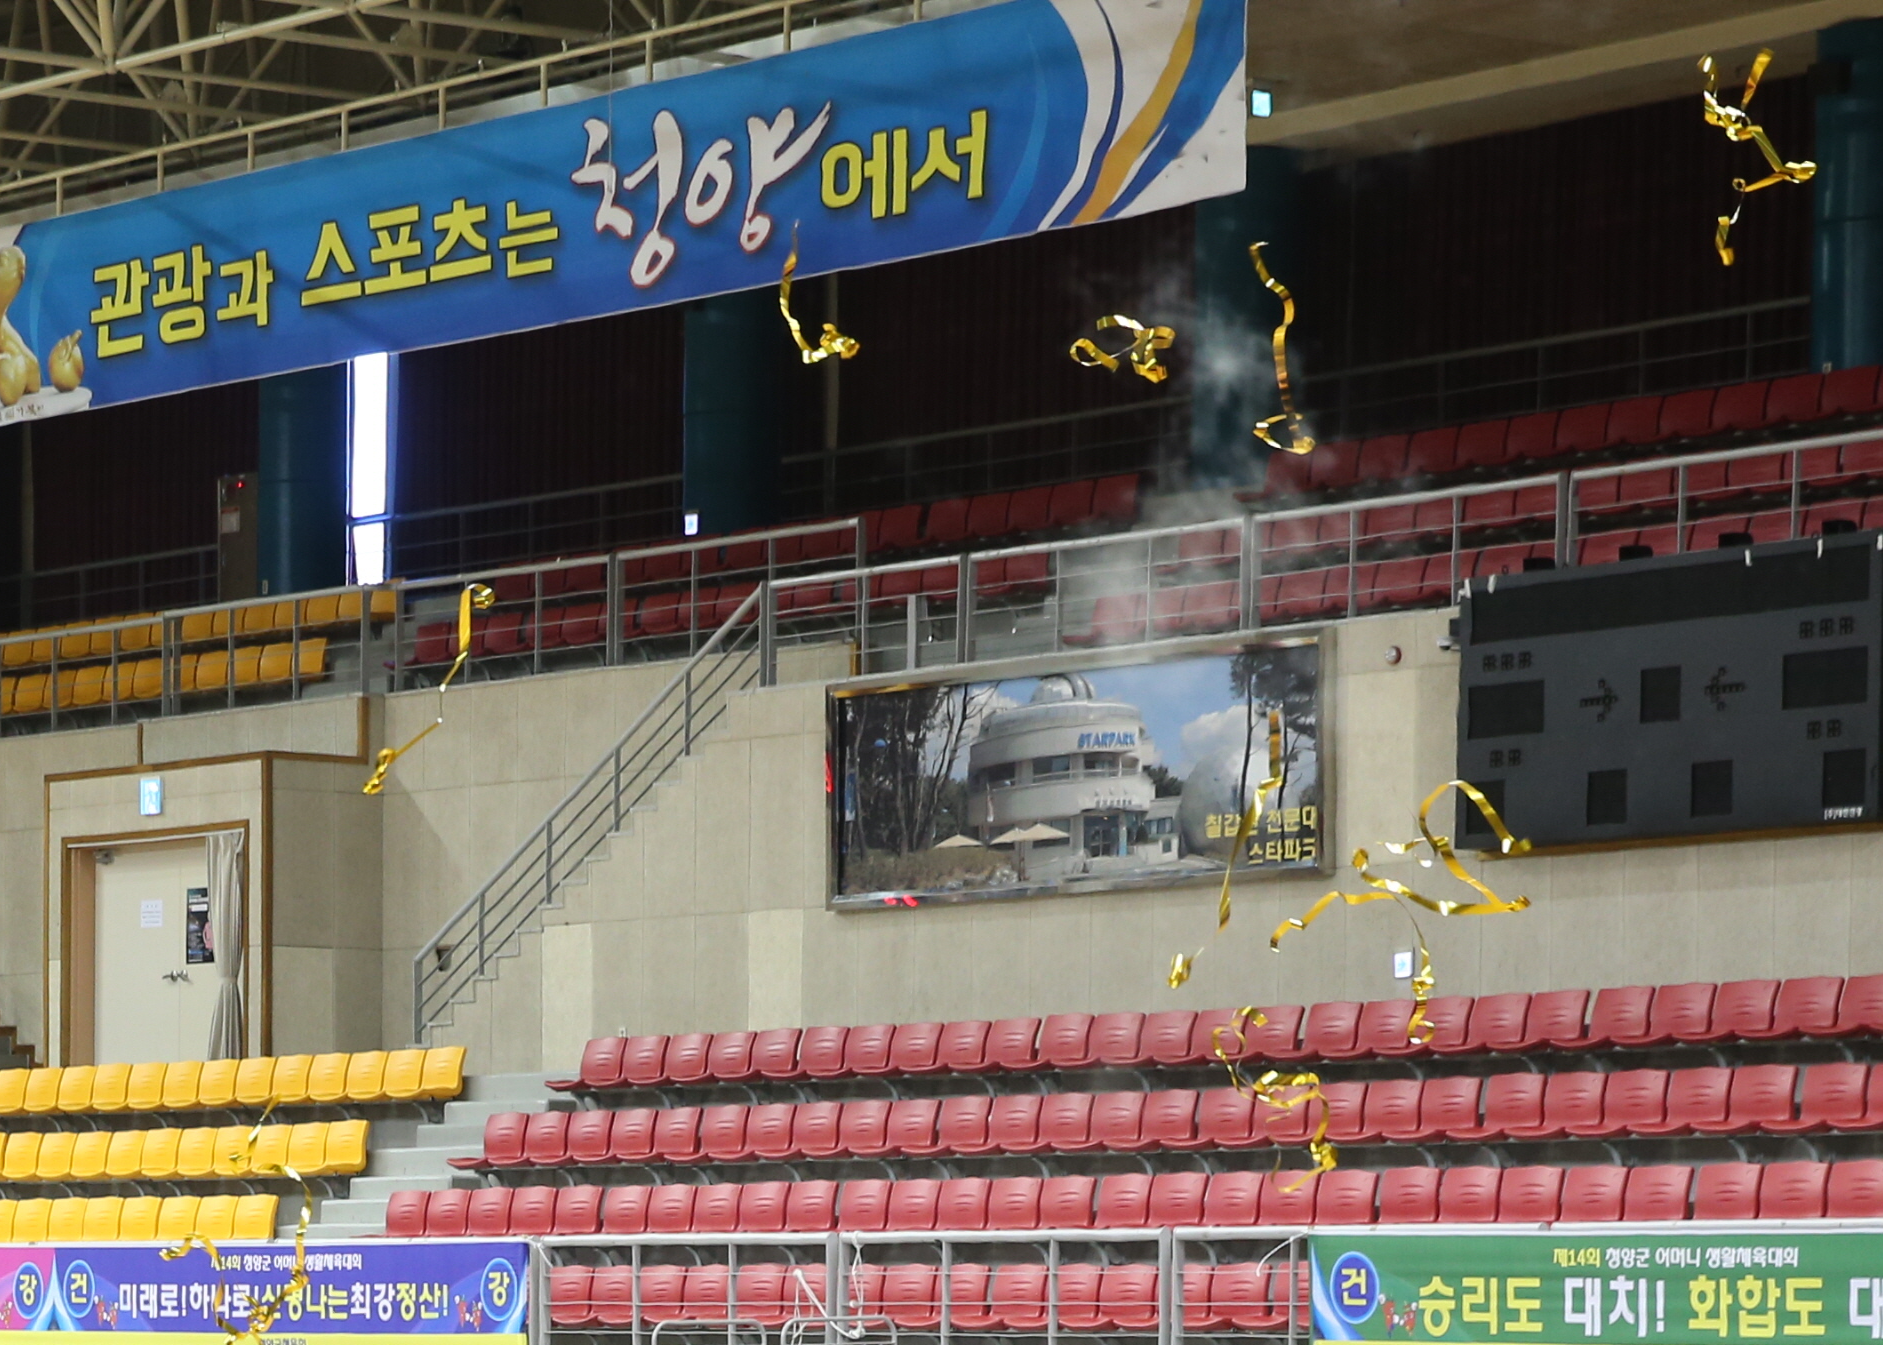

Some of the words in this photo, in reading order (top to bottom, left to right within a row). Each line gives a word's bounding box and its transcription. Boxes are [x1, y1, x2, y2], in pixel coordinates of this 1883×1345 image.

[89, 244, 273, 360] 관광과
[300, 194, 559, 307] 스포츠는
[570, 102, 832, 291] 청양
[821, 109, 987, 222] 에서
[1077, 731, 1136, 749] STARPARK
[1248, 838, 1316, 865] 스타파크
[243, 1254, 271, 1271] 청양군
[305, 1254, 362, 1271] 생활체육대회
[1553, 1247, 1601, 1268] 제14회
[1605, 1247, 1650, 1268] 청양군
[1655, 1247, 1701, 1268] 어머니
[1705, 1247, 1799, 1268] 생활체육대회
[19, 1274, 38, 1305] 강
[69, 1272, 90, 1306] 건
[488, 1270, 511, 1307] 강
[1339, 1267, 1368, 1307] 건
[1418, 1275, 1543, 1337] 승리도
[1564, 1276, 1666, 1338] 대치!
[1688, 1274, 1826, 1338] 화합도
